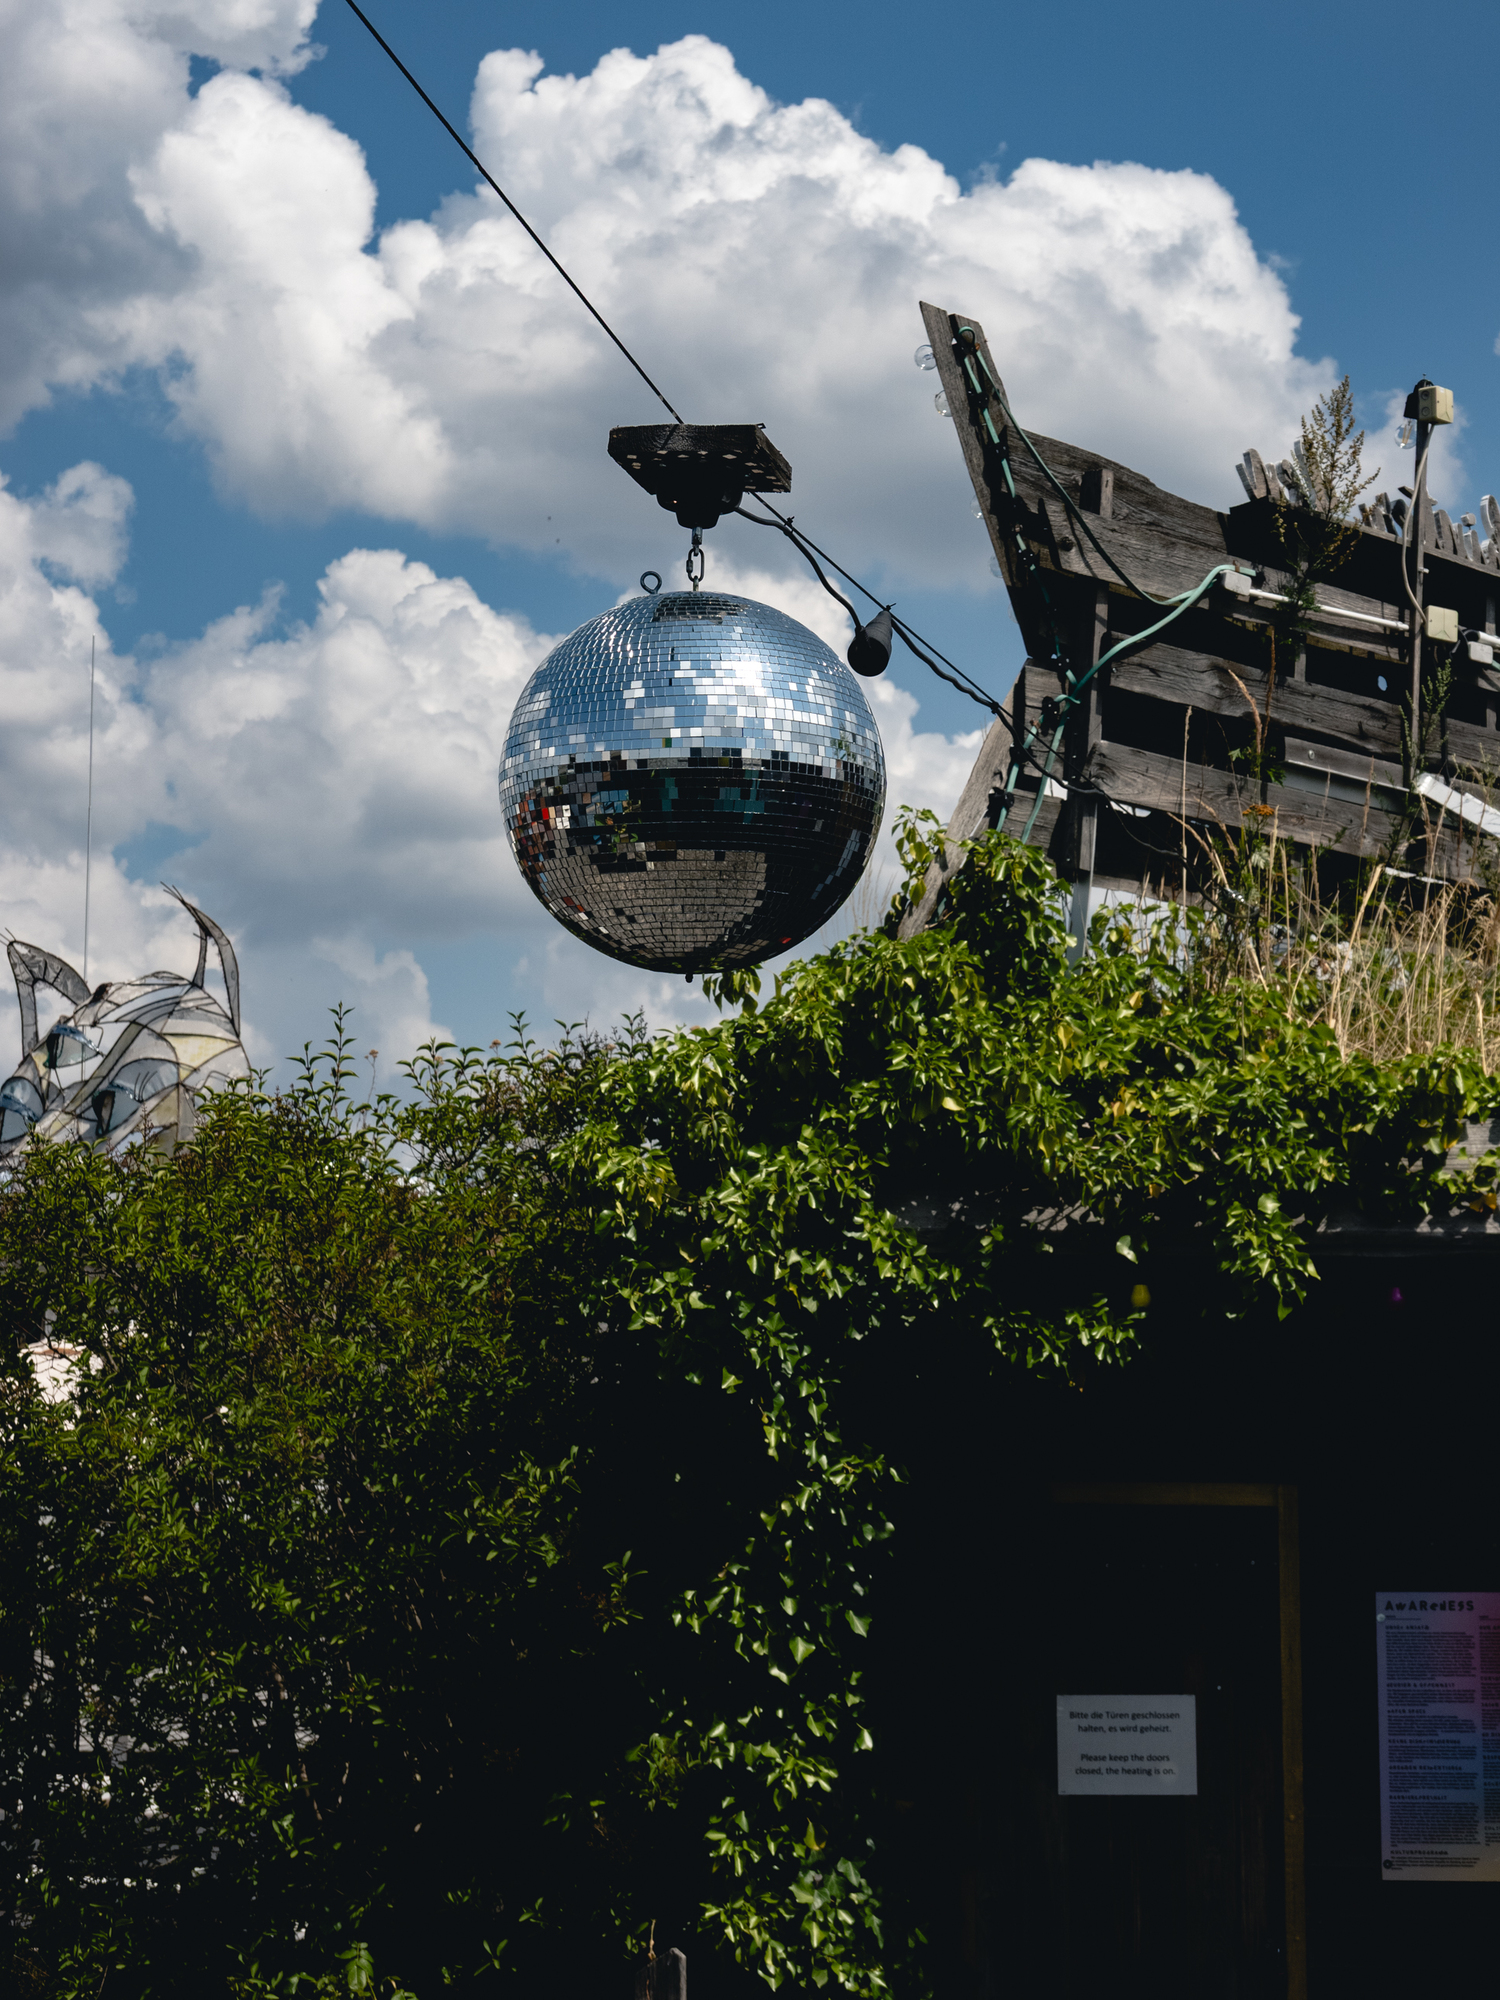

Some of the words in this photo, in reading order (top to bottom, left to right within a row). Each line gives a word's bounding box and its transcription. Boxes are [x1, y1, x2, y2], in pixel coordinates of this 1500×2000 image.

[1069, 1711, 1089, 1720] Bitte
[1090, 1711, 1104, 1720] die
[1105, 1711, 1130, 1720] Türen
[1130, 1711, 1180, 1721] geschlossen
[1077, 1724, 1107, 1733] halten,
[1119, 1725, 1138, 1733] wird
[1139, 1724, 1172, 1734] geheizt.
[1080, 1753, 1107, 1762] Please
[1108, 1753, 1129, 1763] keep
[1130, 1753, 1145, 1762] the
[1146, 1754, 1170, 1762] doors
[1075, 1767, 1104, 1776] closed,
[1105, 1767, 1120, 1775] the
[1121, 1767, 1153, 1777] heating
[1154, 1767, 1161, 1775] is
